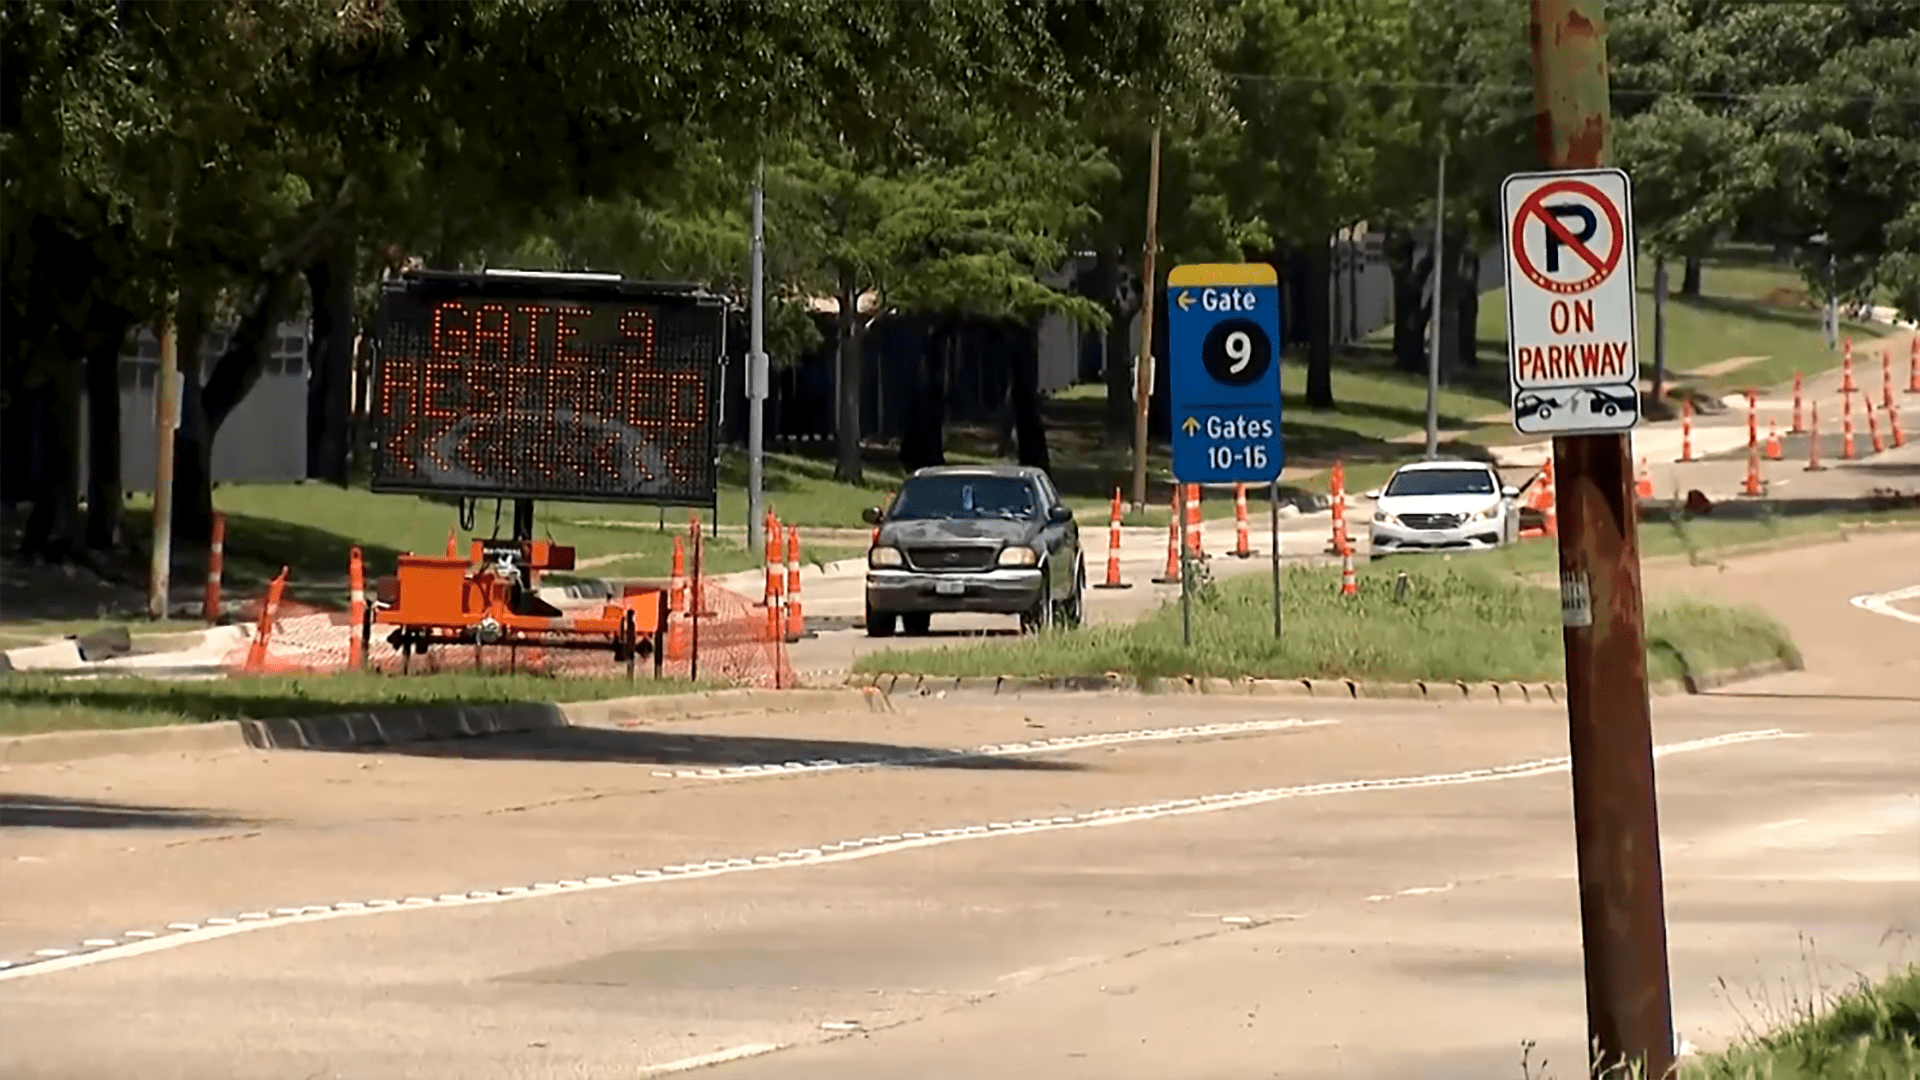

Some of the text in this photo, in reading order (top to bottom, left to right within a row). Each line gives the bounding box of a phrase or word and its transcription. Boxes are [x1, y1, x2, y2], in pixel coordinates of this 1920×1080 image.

[1545, 204, 1597, 273] P
[1202, 288, 1256, 312] Gate
[1550, 298, 1594, 335] ON
[432, 301, 654, 364] GATE 9
[1225, 331, 1252, 375] 9
[1518, 341, 1628, 381] PARKWAY
[382, 359, 706, 428] RESERVED
[1207, 414, 1274, 440] Gates
